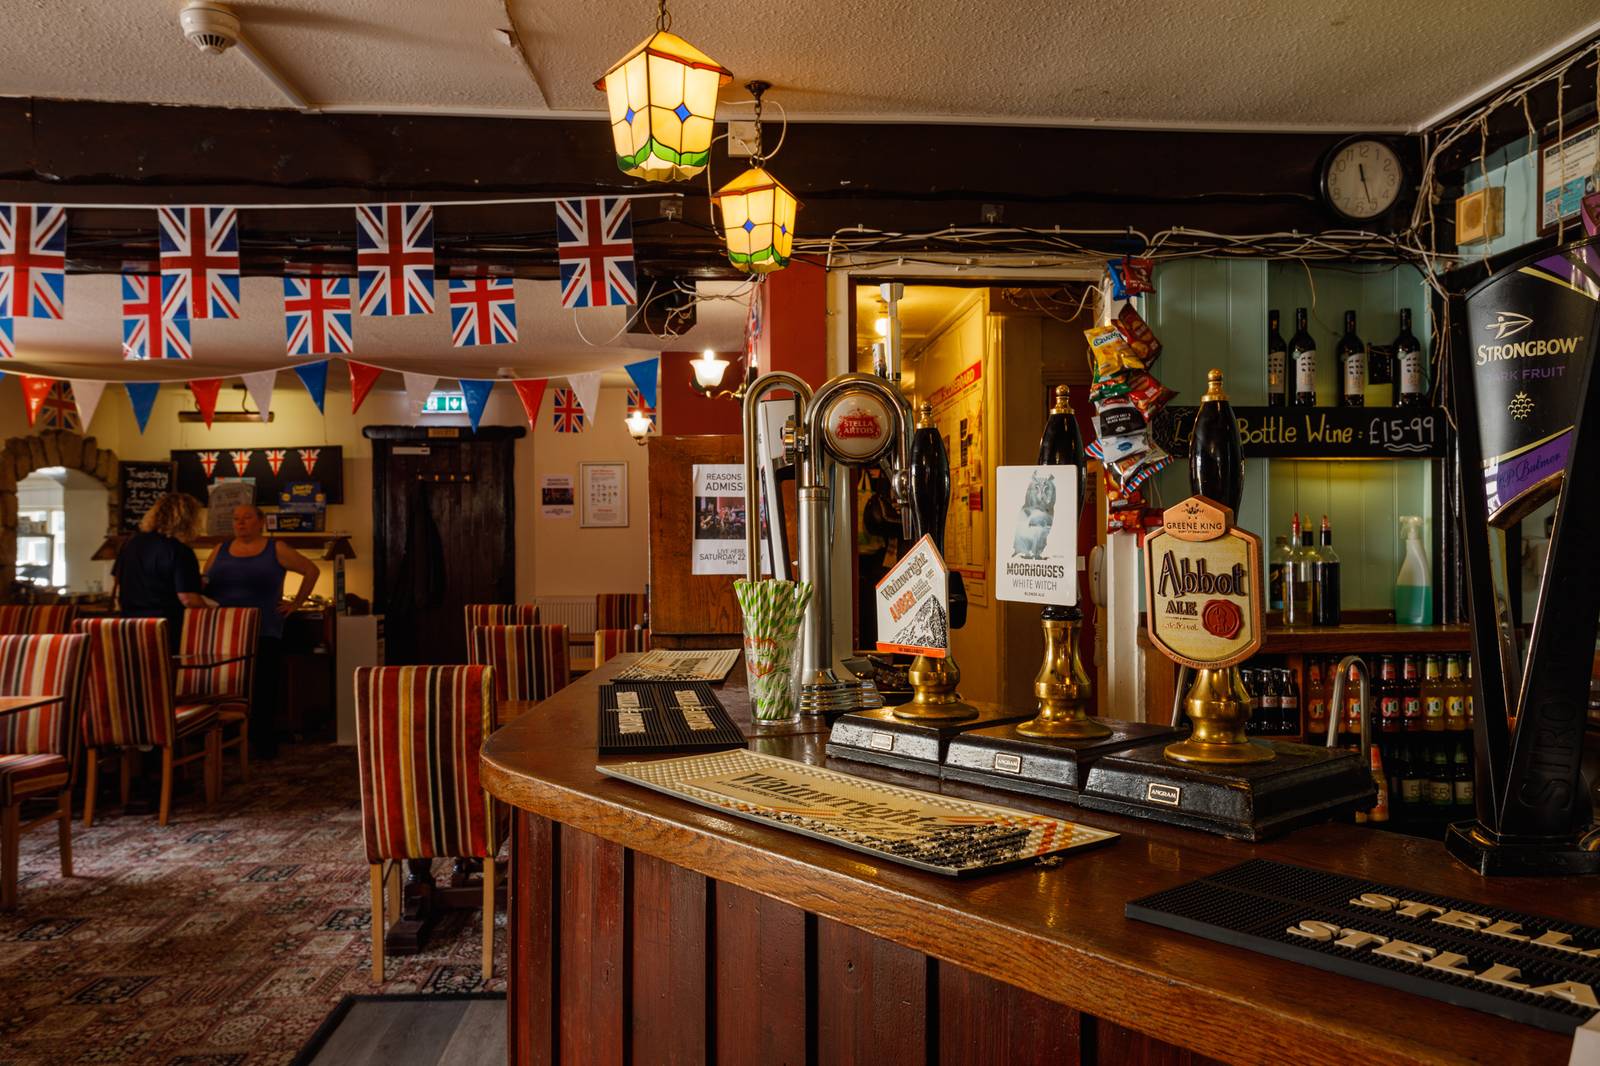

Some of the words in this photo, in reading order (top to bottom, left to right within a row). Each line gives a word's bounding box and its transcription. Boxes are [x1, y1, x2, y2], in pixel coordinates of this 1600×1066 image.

[1476, 337, 1578, 366] STRONGBOW
[1522, 366, 1566, 380] FRUIT
[1238, 416, 1296, 444] Bottle
[1369, 416, 1434, 444] £15-99
[880, 552, 928, 600] Wainwright
[1012, 579, 1033, 589] WHITE
[1034, 580, 1057, 591] WITCH
[1158, 550, 1246, 598] Abbot
[1166, 600, 1198, 616] ALE
[731, 772, 938, 826] Wainwright
[1152, 789, 1176, 798] ANGRAM
[1286, 920, 1600, 1008] STELLA
